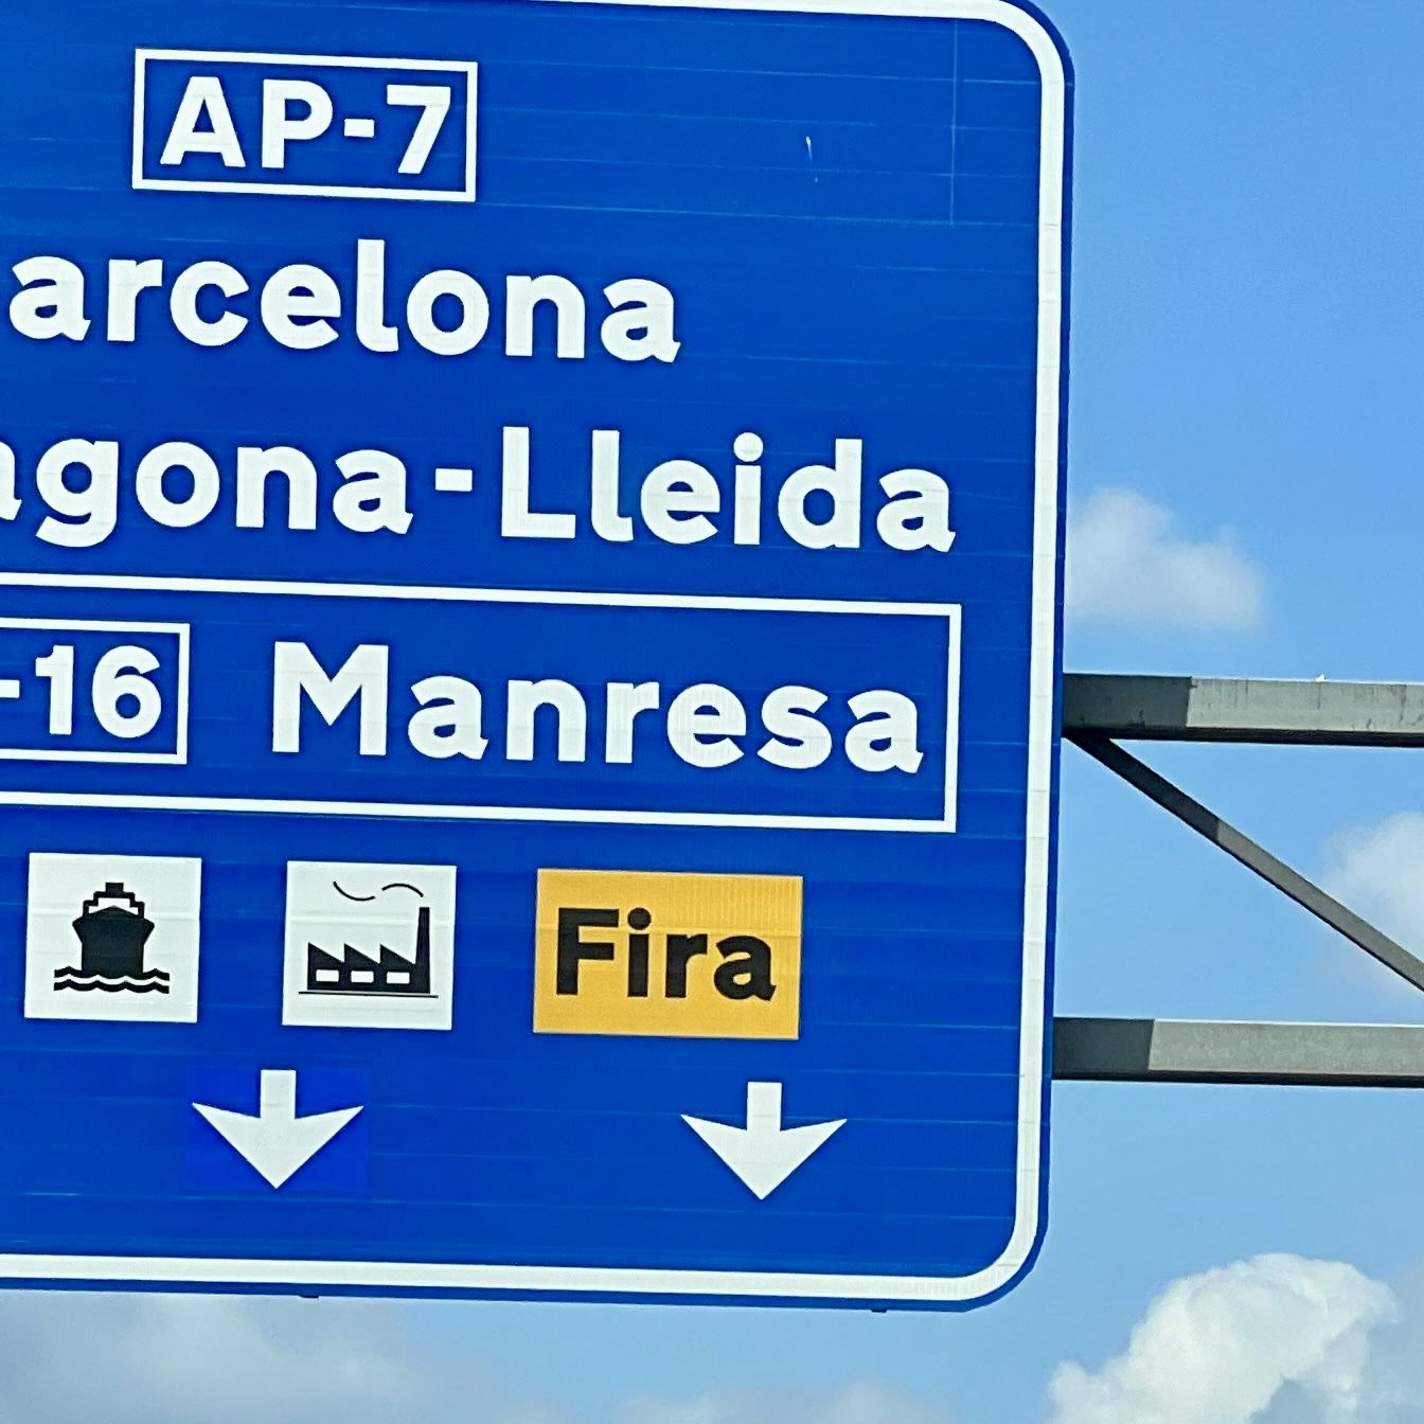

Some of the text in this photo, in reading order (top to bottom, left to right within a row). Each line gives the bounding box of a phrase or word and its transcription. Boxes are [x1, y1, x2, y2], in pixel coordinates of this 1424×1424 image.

[160, 76, 451, 175] AP-7
[10, 240, 681, 363] arcelona
[272, 641, 924, 773] Manresa
[556, 907, 776, 1002] Fira
